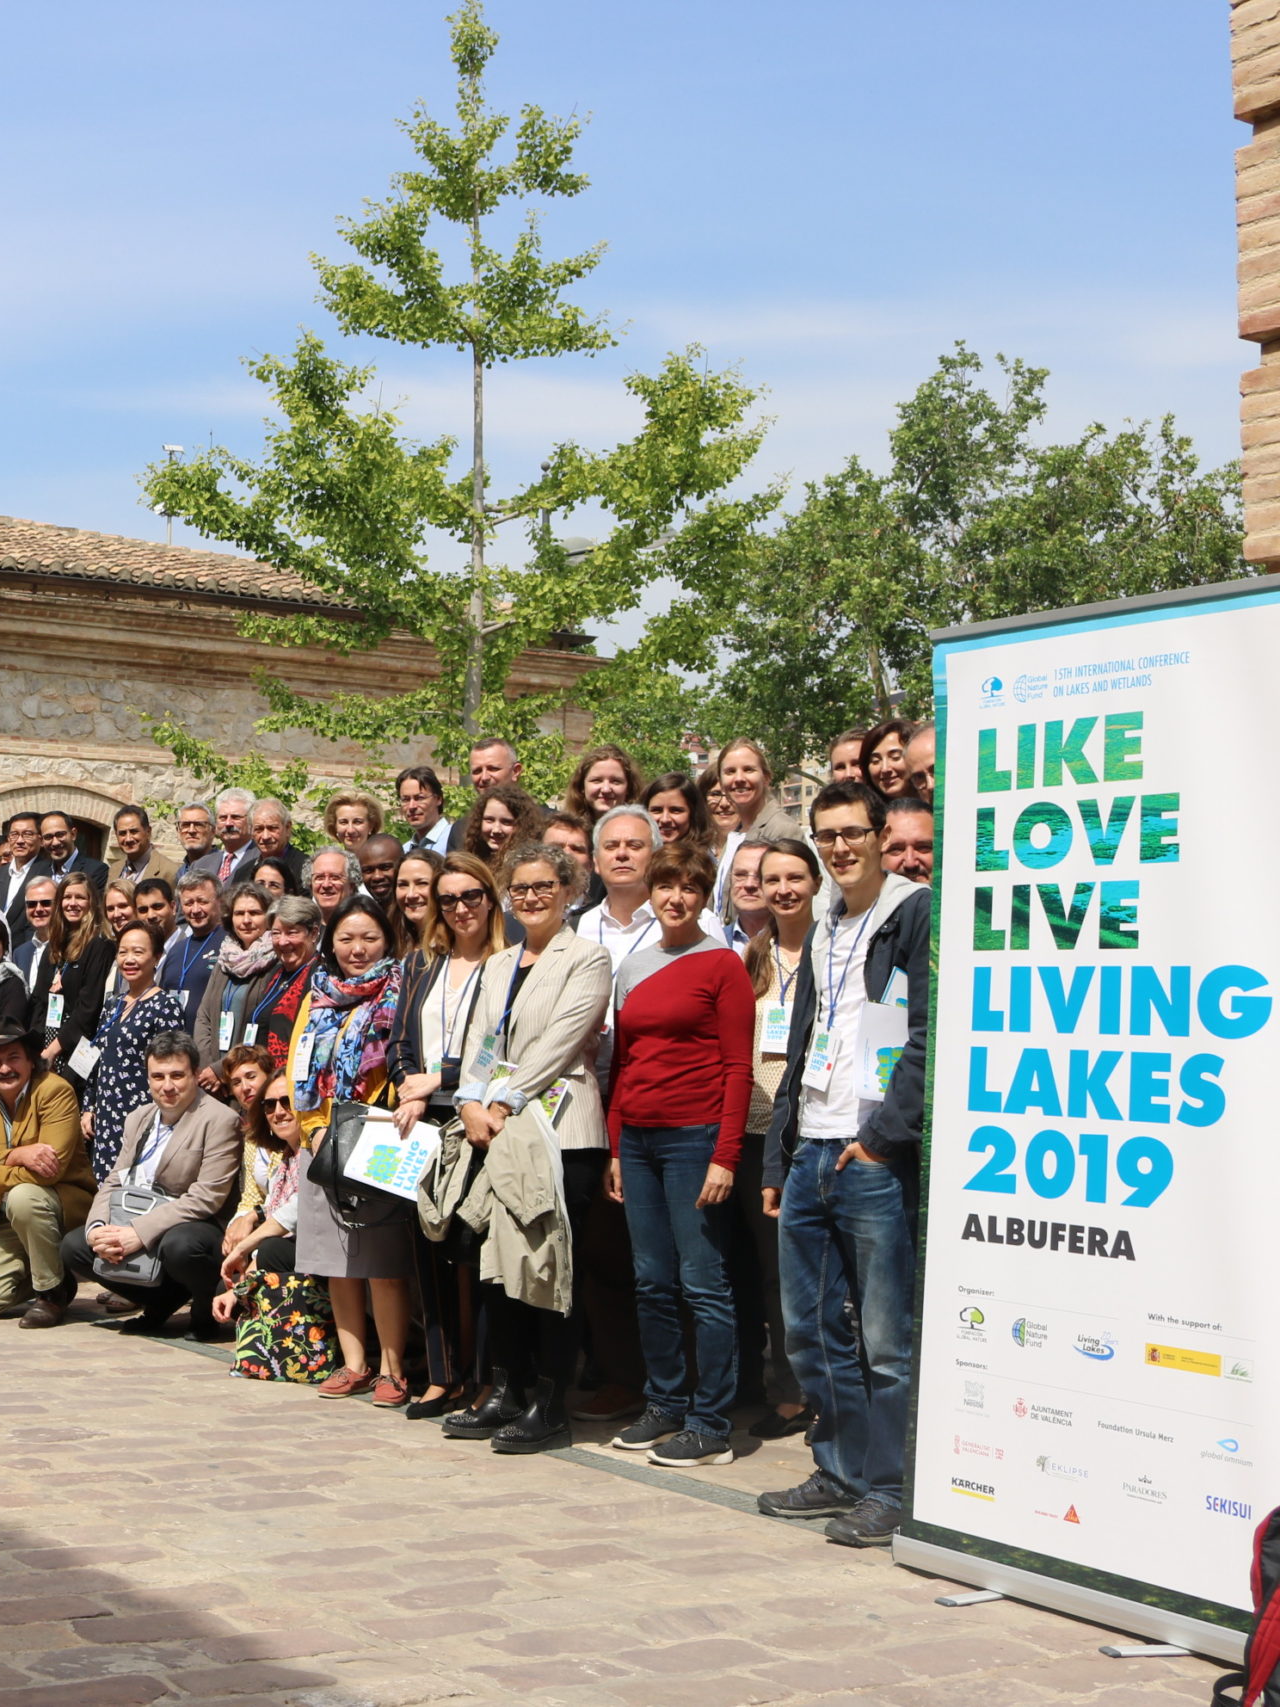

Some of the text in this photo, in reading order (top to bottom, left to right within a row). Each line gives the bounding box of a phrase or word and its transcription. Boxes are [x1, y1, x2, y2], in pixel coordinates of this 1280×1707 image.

[1054, 651, 1190, 680] 15TH INTERNATIONAL CONFERENCE
[1028, 675, 1048, 684] Global
[1028, 683, 1048, 692] Nature
[1053, 674, 1152, 698] ON LAKES AND WETLANDS
[977, 711, 1144, 793] LIKE
[975, 792, 1180, 872] LOVE
[973, 880, 1140, 951] LIVE
[972, 964, 1273, 1040] LIVING
[968, 1046, 1226, 1128] LAKES
[393, 1140, 420, 1188] LIVING
[403, 1149, 428, 1191] LAKES
[962, 1126, 1174, 1208] 2019
[960, 1213, 1136, 1262] ALBUFERA
[958, 1285, 995, 1296] Organizer:
[1026, 1320, 1048, 1332] Global
[1148, 1312, 1222, 1332] With the support of:
[1026, 1330, 1048, 1340] Nature
[1026, 1338, 1042, 1348] Fund
[1077, 1334, 1100, 1347] Living
[1082, 1344, 1104, 1354] Lakes
[955, 1358, 988, 1370] Sponsors:
[1030, 1412, 1040, 1420] DE
[1031, 1404, 1072, 1418] AJUNTAMENT
[1097, 1420, 1174, 1444] Foundation Ursula Merz
[1200, 1450, 1254, 1468] global omnium
[1051, 1462, 1089, 1478] EKLIPSE
[1122, 1482, 1168, 1500] PARADORES
[1206, 1495, 1252, 1520] SEKISUI
